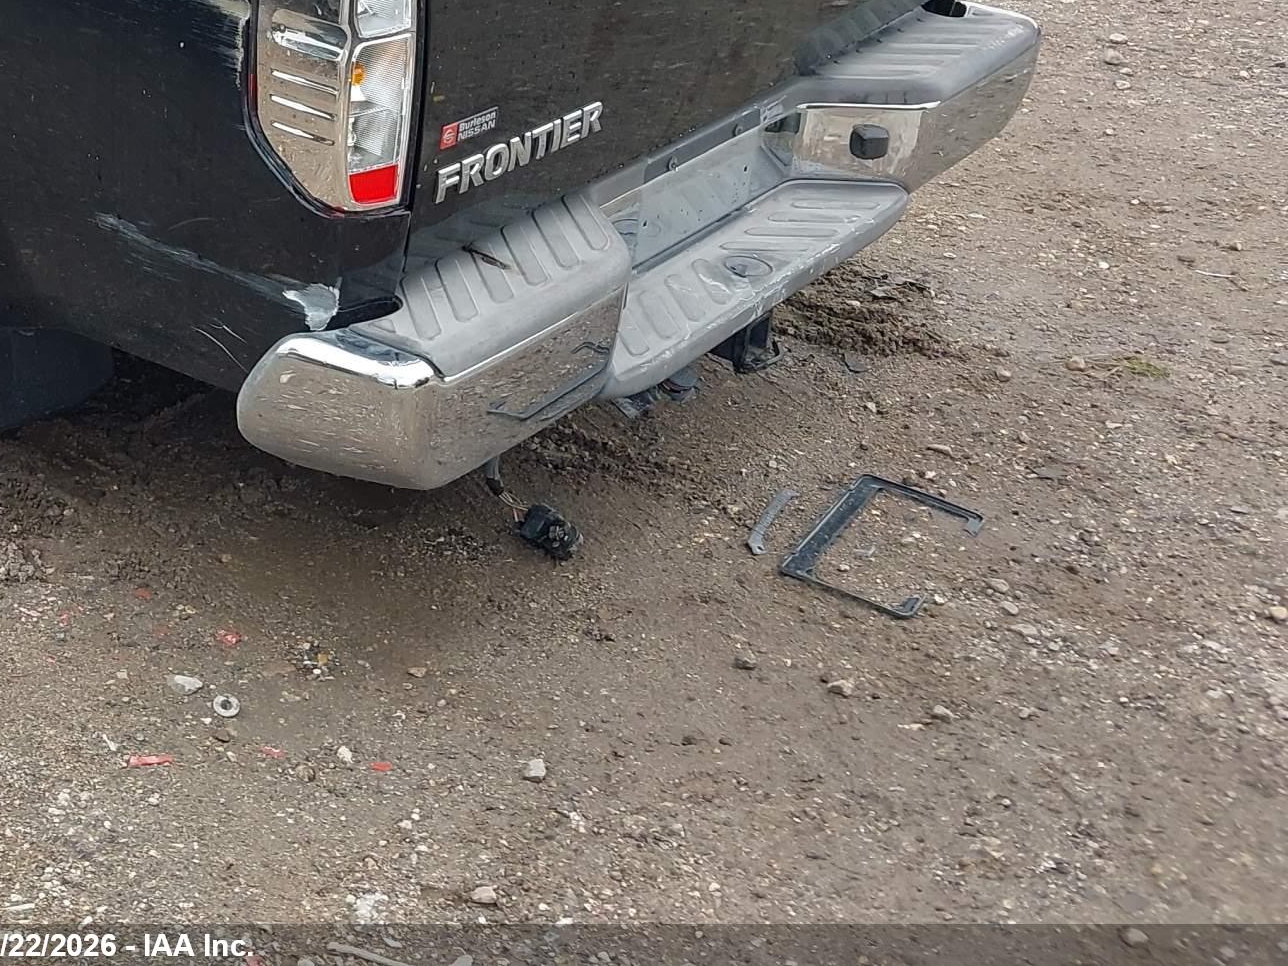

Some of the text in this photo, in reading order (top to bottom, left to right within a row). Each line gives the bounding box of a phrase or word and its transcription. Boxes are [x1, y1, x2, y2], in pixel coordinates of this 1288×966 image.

[457, 119, 496, 142] NISSAN
[459, 111, 496, 132] Burleson
[434, 101, 604, 205] FRONTIER
